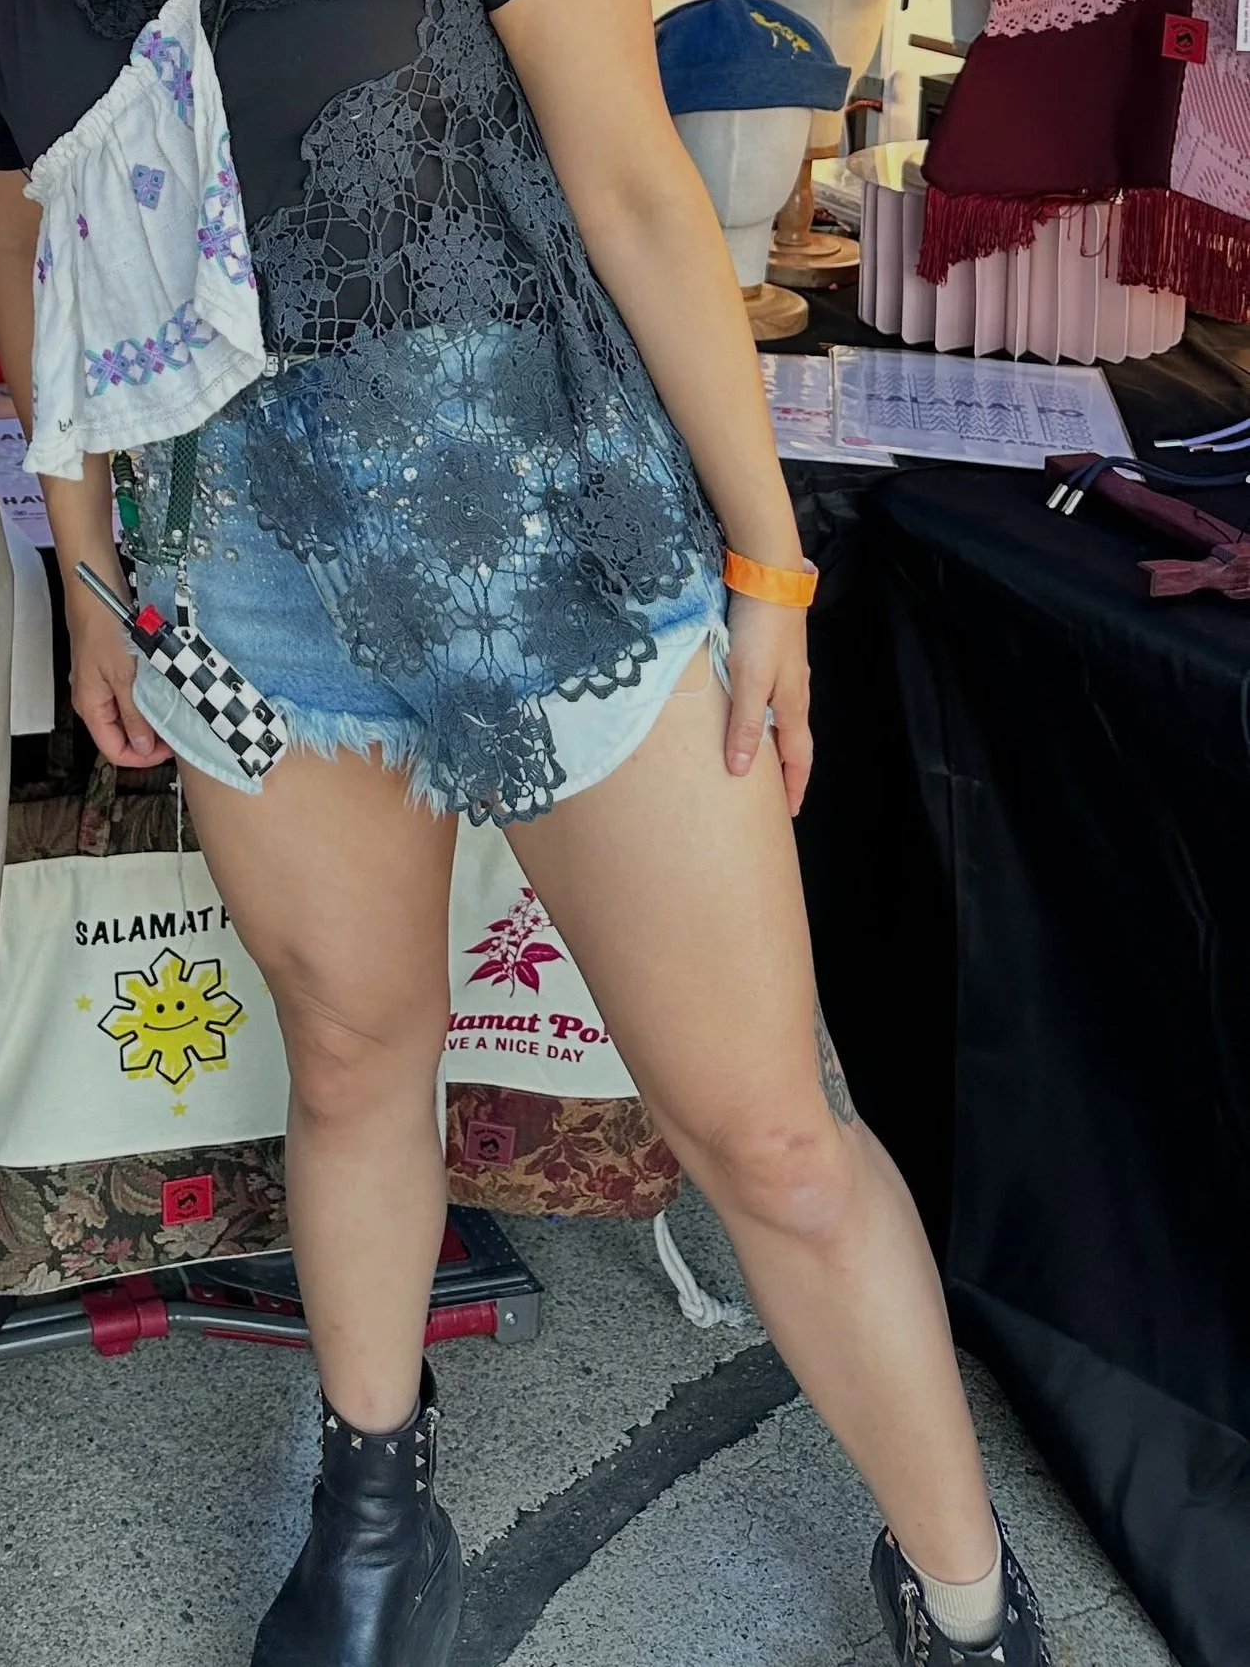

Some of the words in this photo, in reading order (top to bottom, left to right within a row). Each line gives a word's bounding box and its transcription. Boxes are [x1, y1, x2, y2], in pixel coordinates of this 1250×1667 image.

[75, 906, 213, 946] SALAMAT
[448, 1012, 542, 1033] lamat
[443, 1037, 470, 1051] VE
[474, 1036, 488, 1050] A
[495, 1037, 540, 1056] NICE
[546, 1044, 585, 1063] DAY
